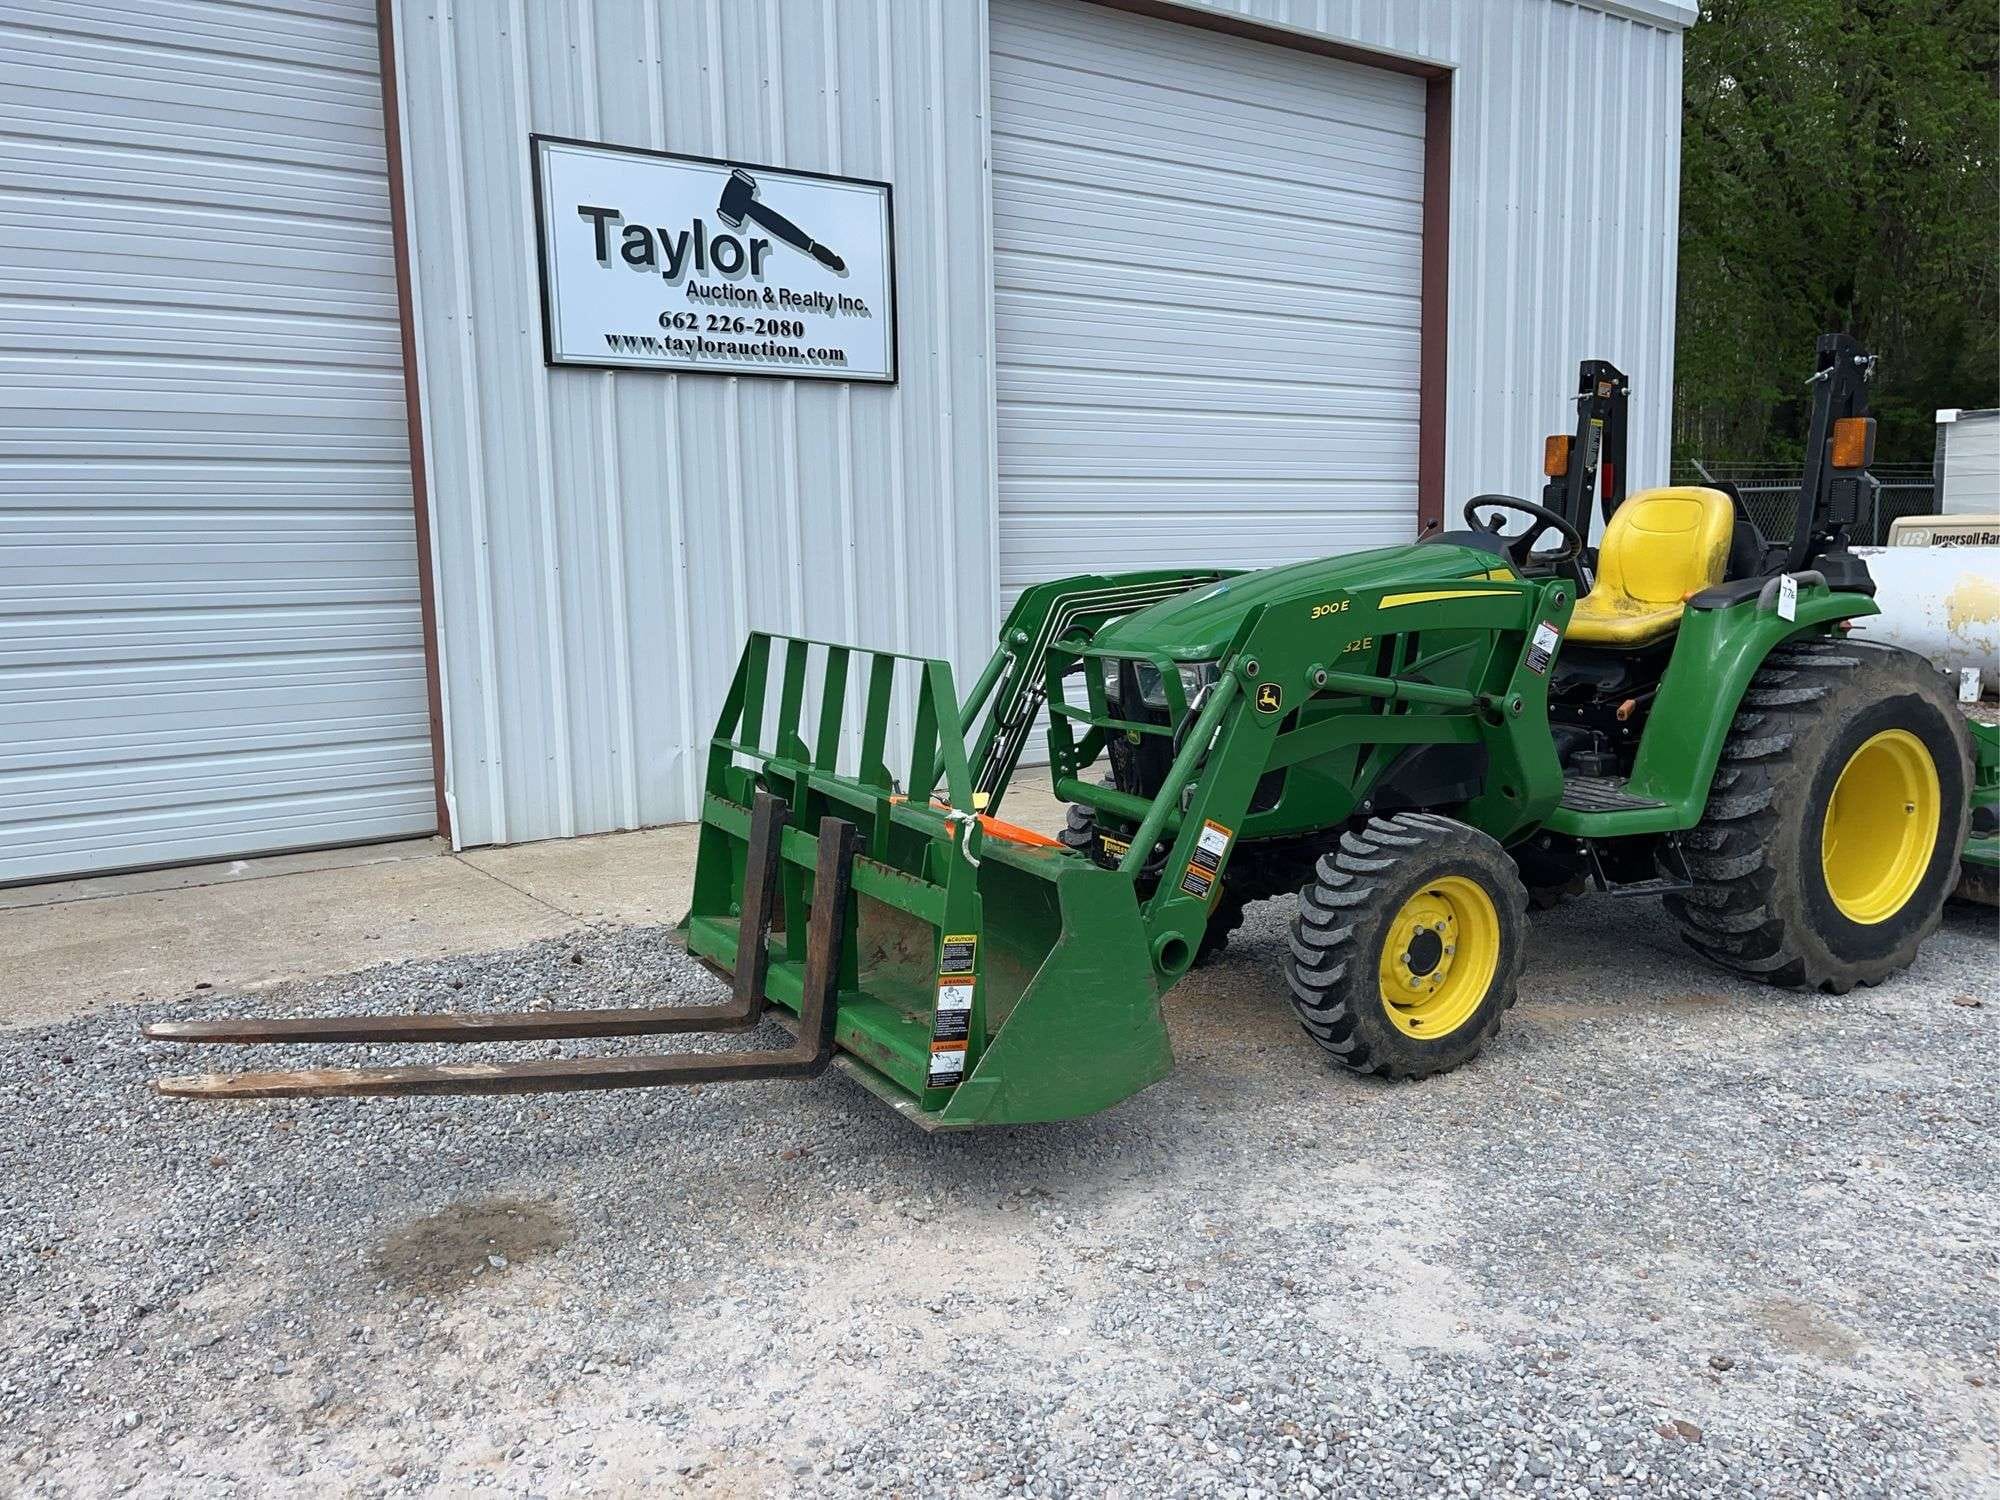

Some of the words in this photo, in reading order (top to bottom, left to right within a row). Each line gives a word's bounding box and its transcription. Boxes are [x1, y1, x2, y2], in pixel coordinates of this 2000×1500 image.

[578, 205, 770, 281] Taylor
[686, 280, 758, 303] Auction
[763, 287, 775, 304] &
[779, 288, 834, 312] Realty
[839, 293, 869, 312] Inc.
[658, 311, 699, 331] 662
[706, 314, 805, 338] 226-2080
[604, 334, 845, 362] www.taylorauction.com
